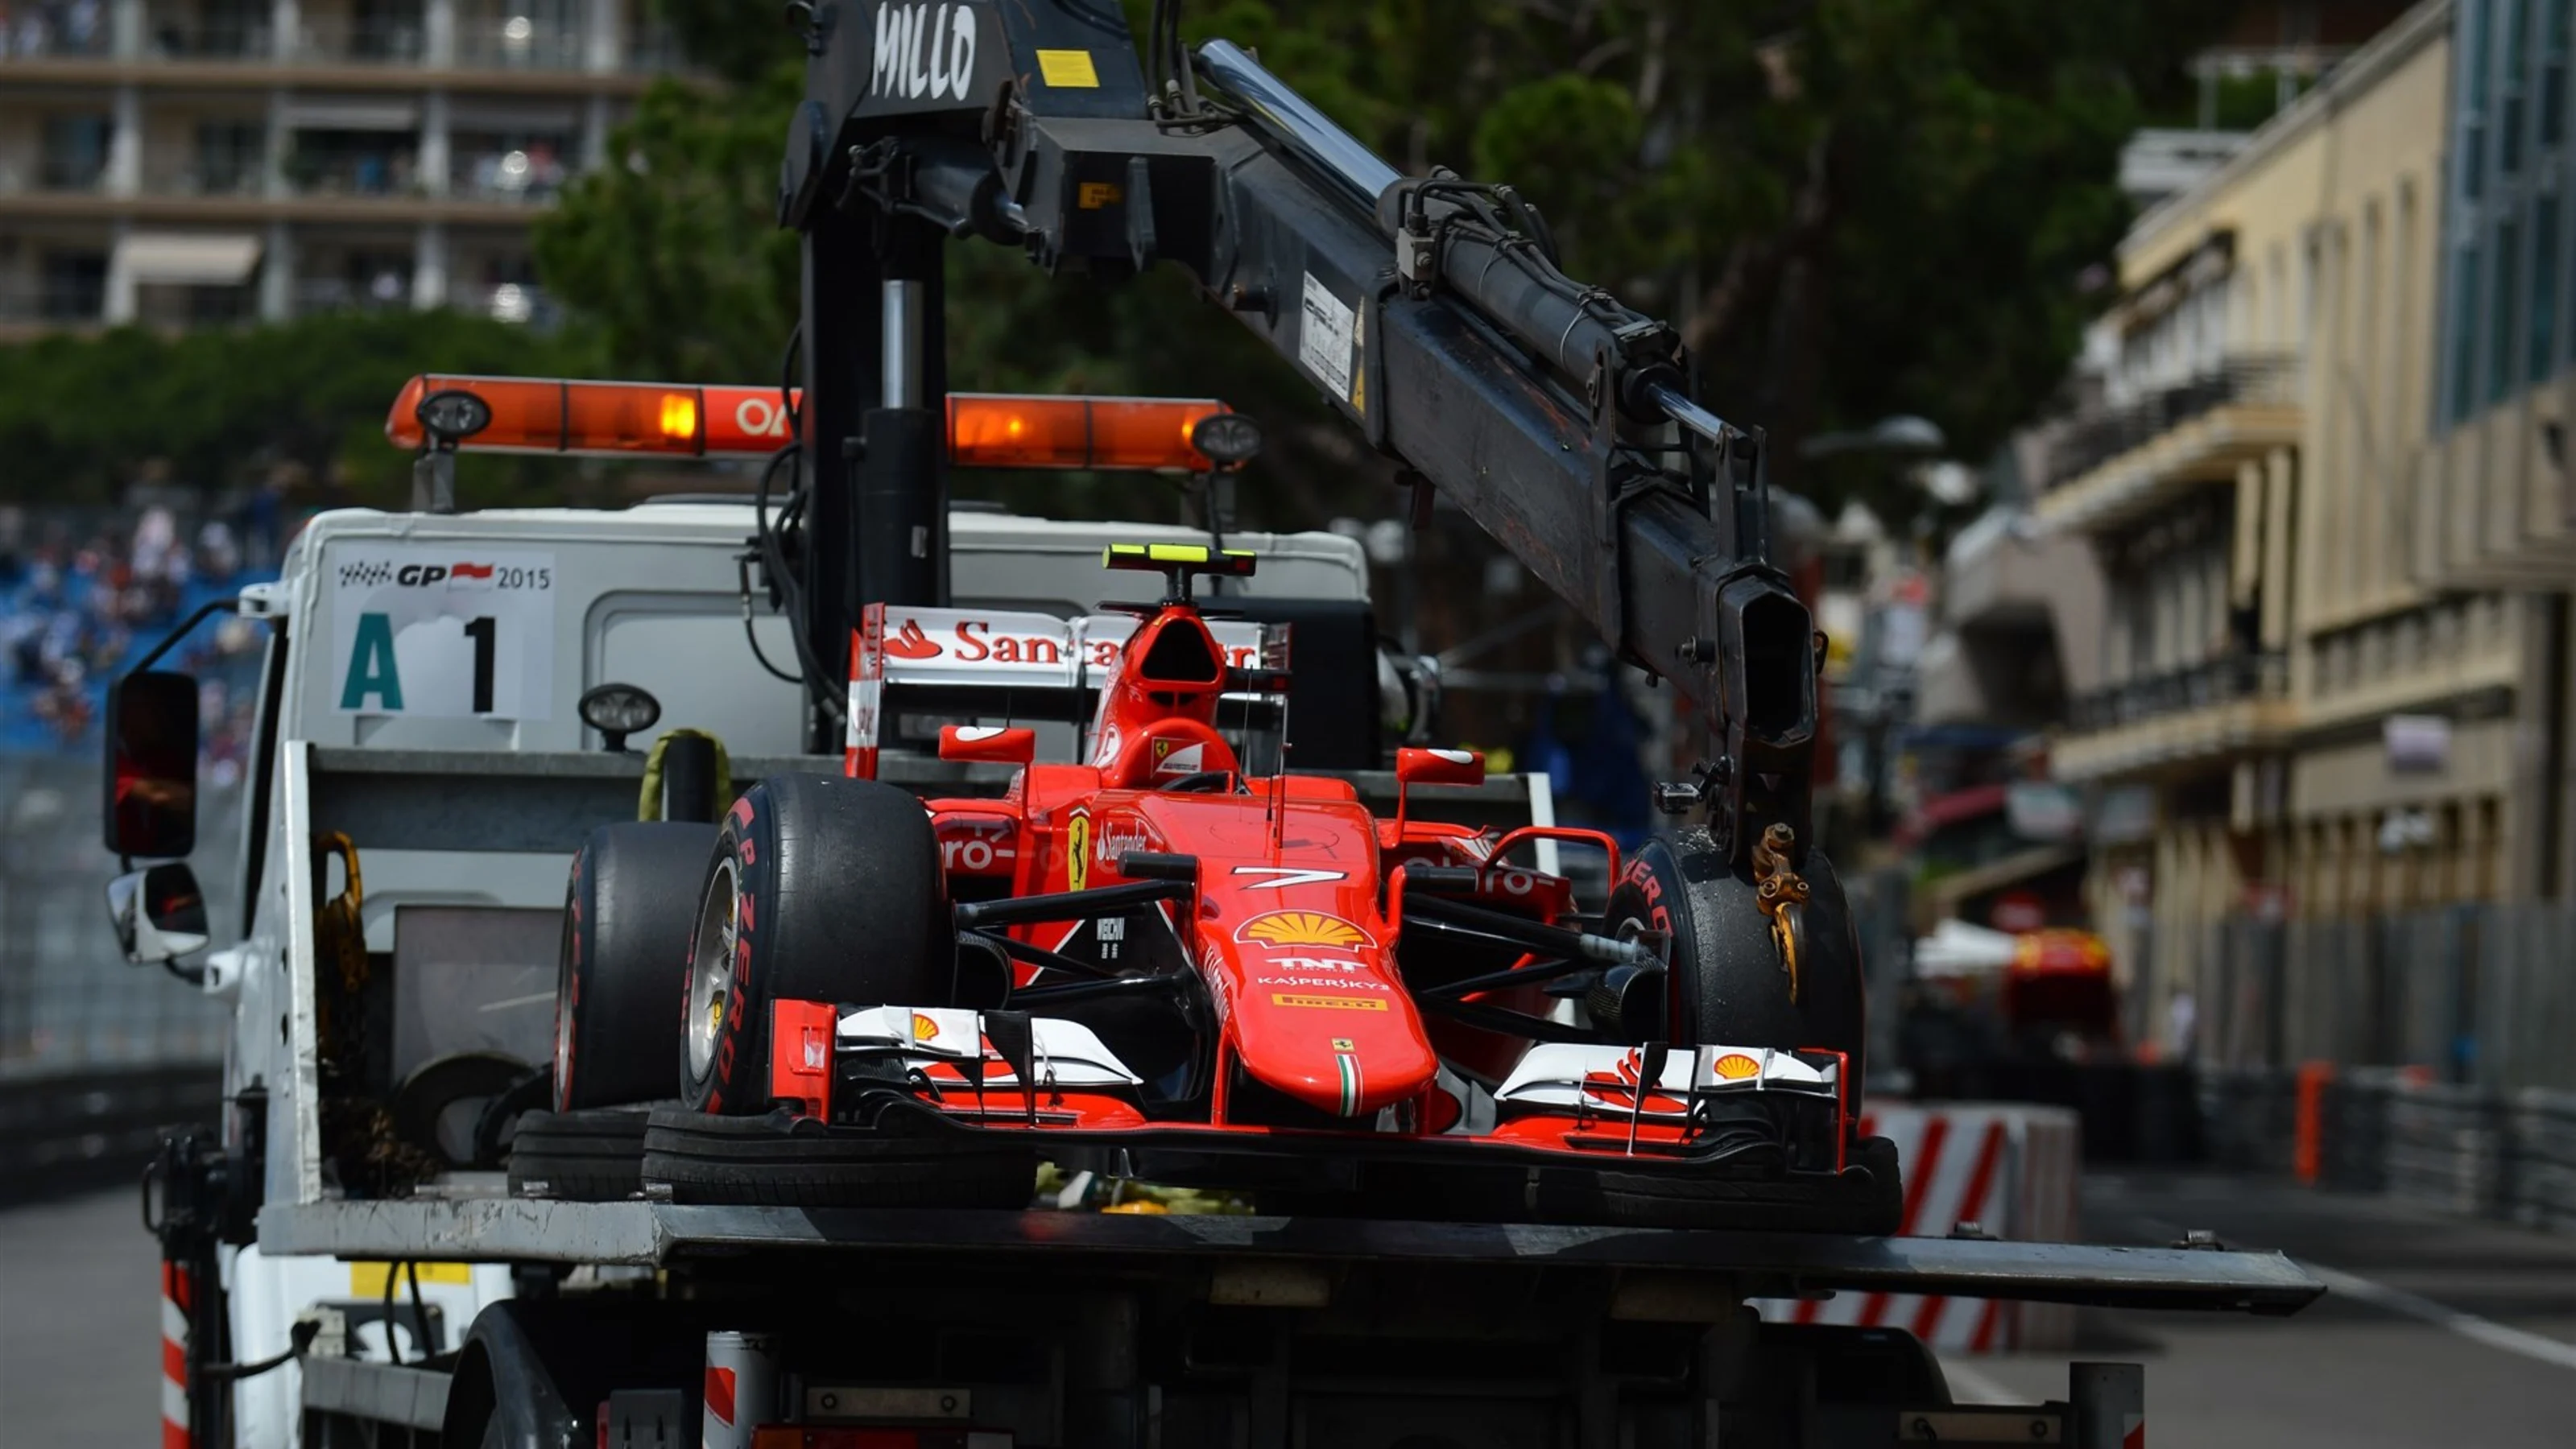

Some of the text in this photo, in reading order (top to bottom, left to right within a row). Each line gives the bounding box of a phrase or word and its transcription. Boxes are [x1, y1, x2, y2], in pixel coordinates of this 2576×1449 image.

[871, 1, 976, 101] MILLO
[396, 565, 550, 590] GP 2015
[339, 613, 496, 713] A 1
[1230, 865, 1350, 891] 7
[1265, 957, 1369, 971] TNT
[719, 891, 755, 1085] ZERO
[1257, 976, 1379, 990] KASPERSKY
